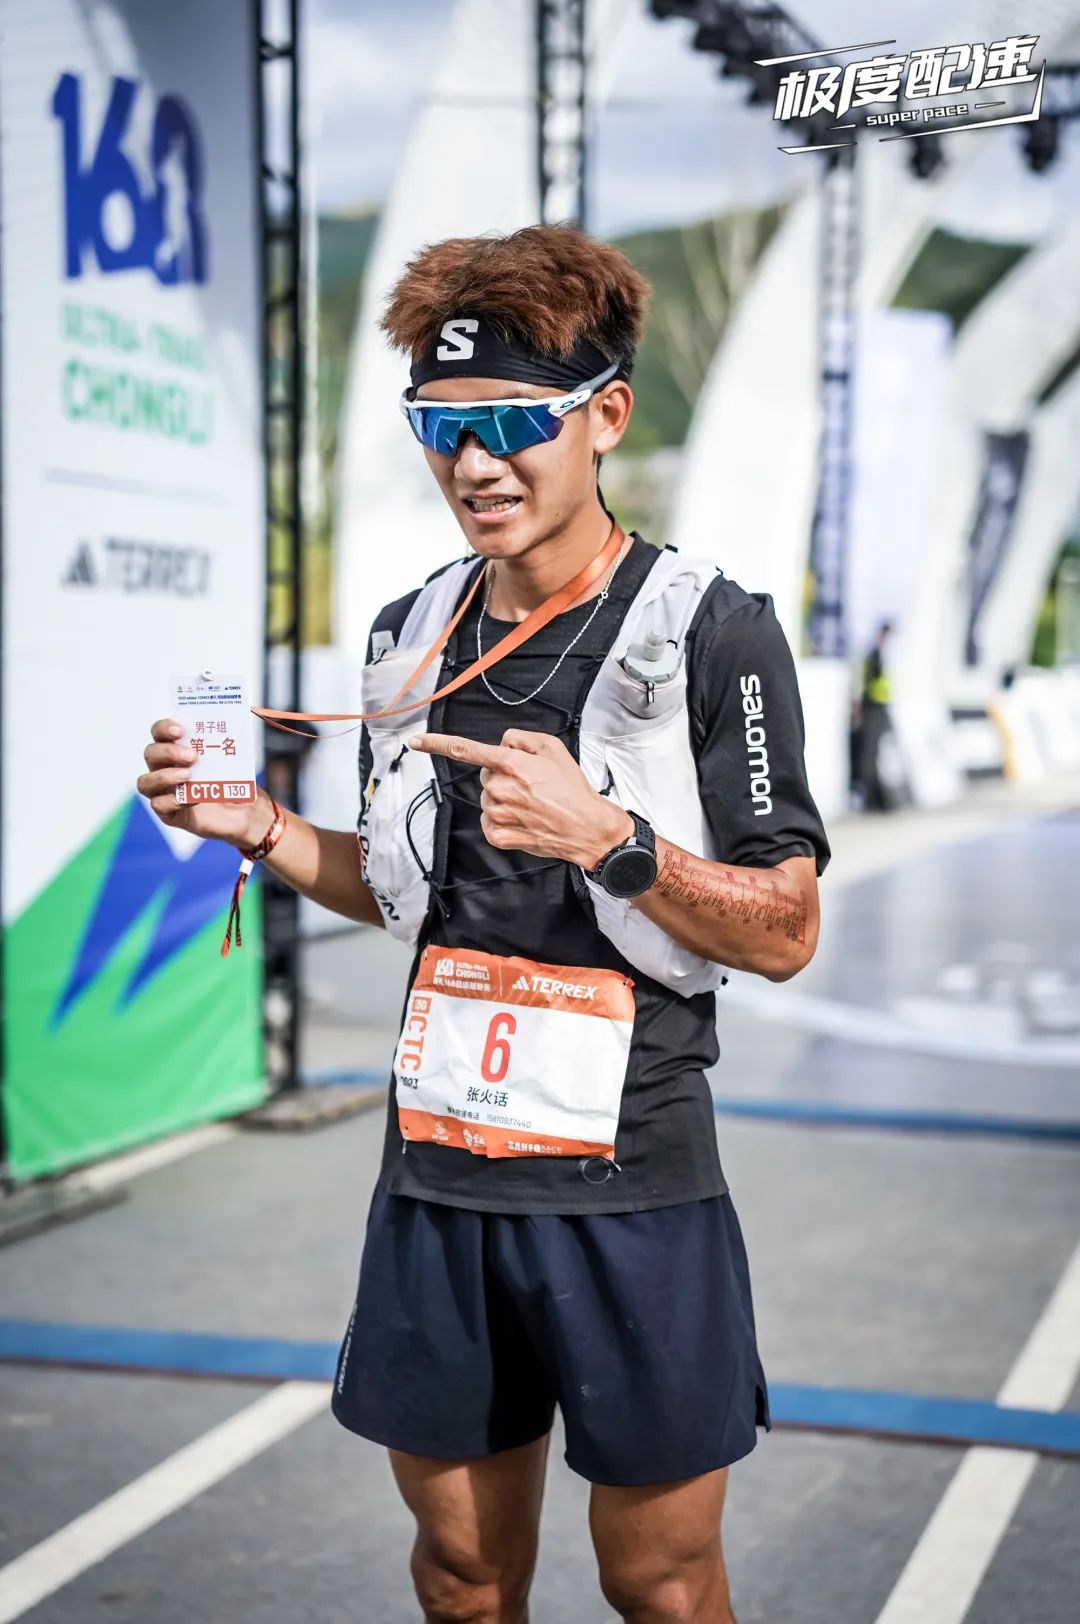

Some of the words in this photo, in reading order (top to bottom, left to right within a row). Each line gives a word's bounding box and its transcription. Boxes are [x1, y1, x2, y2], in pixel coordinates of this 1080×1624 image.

[437, 318, 480, 361] S
[195, 721, 228, 733] 男子组
[190, 738, 236, 756] 第一名
[190, 784, 220, 799] CTC
[228, 786, 246, 797] 130
[531, 976, 598, 1001] TERREX
[400, 1015, 427, 1072] CTC
[481, 1012, 517, 1083] 6
[466, 1086, 509, 1107] 张火话
